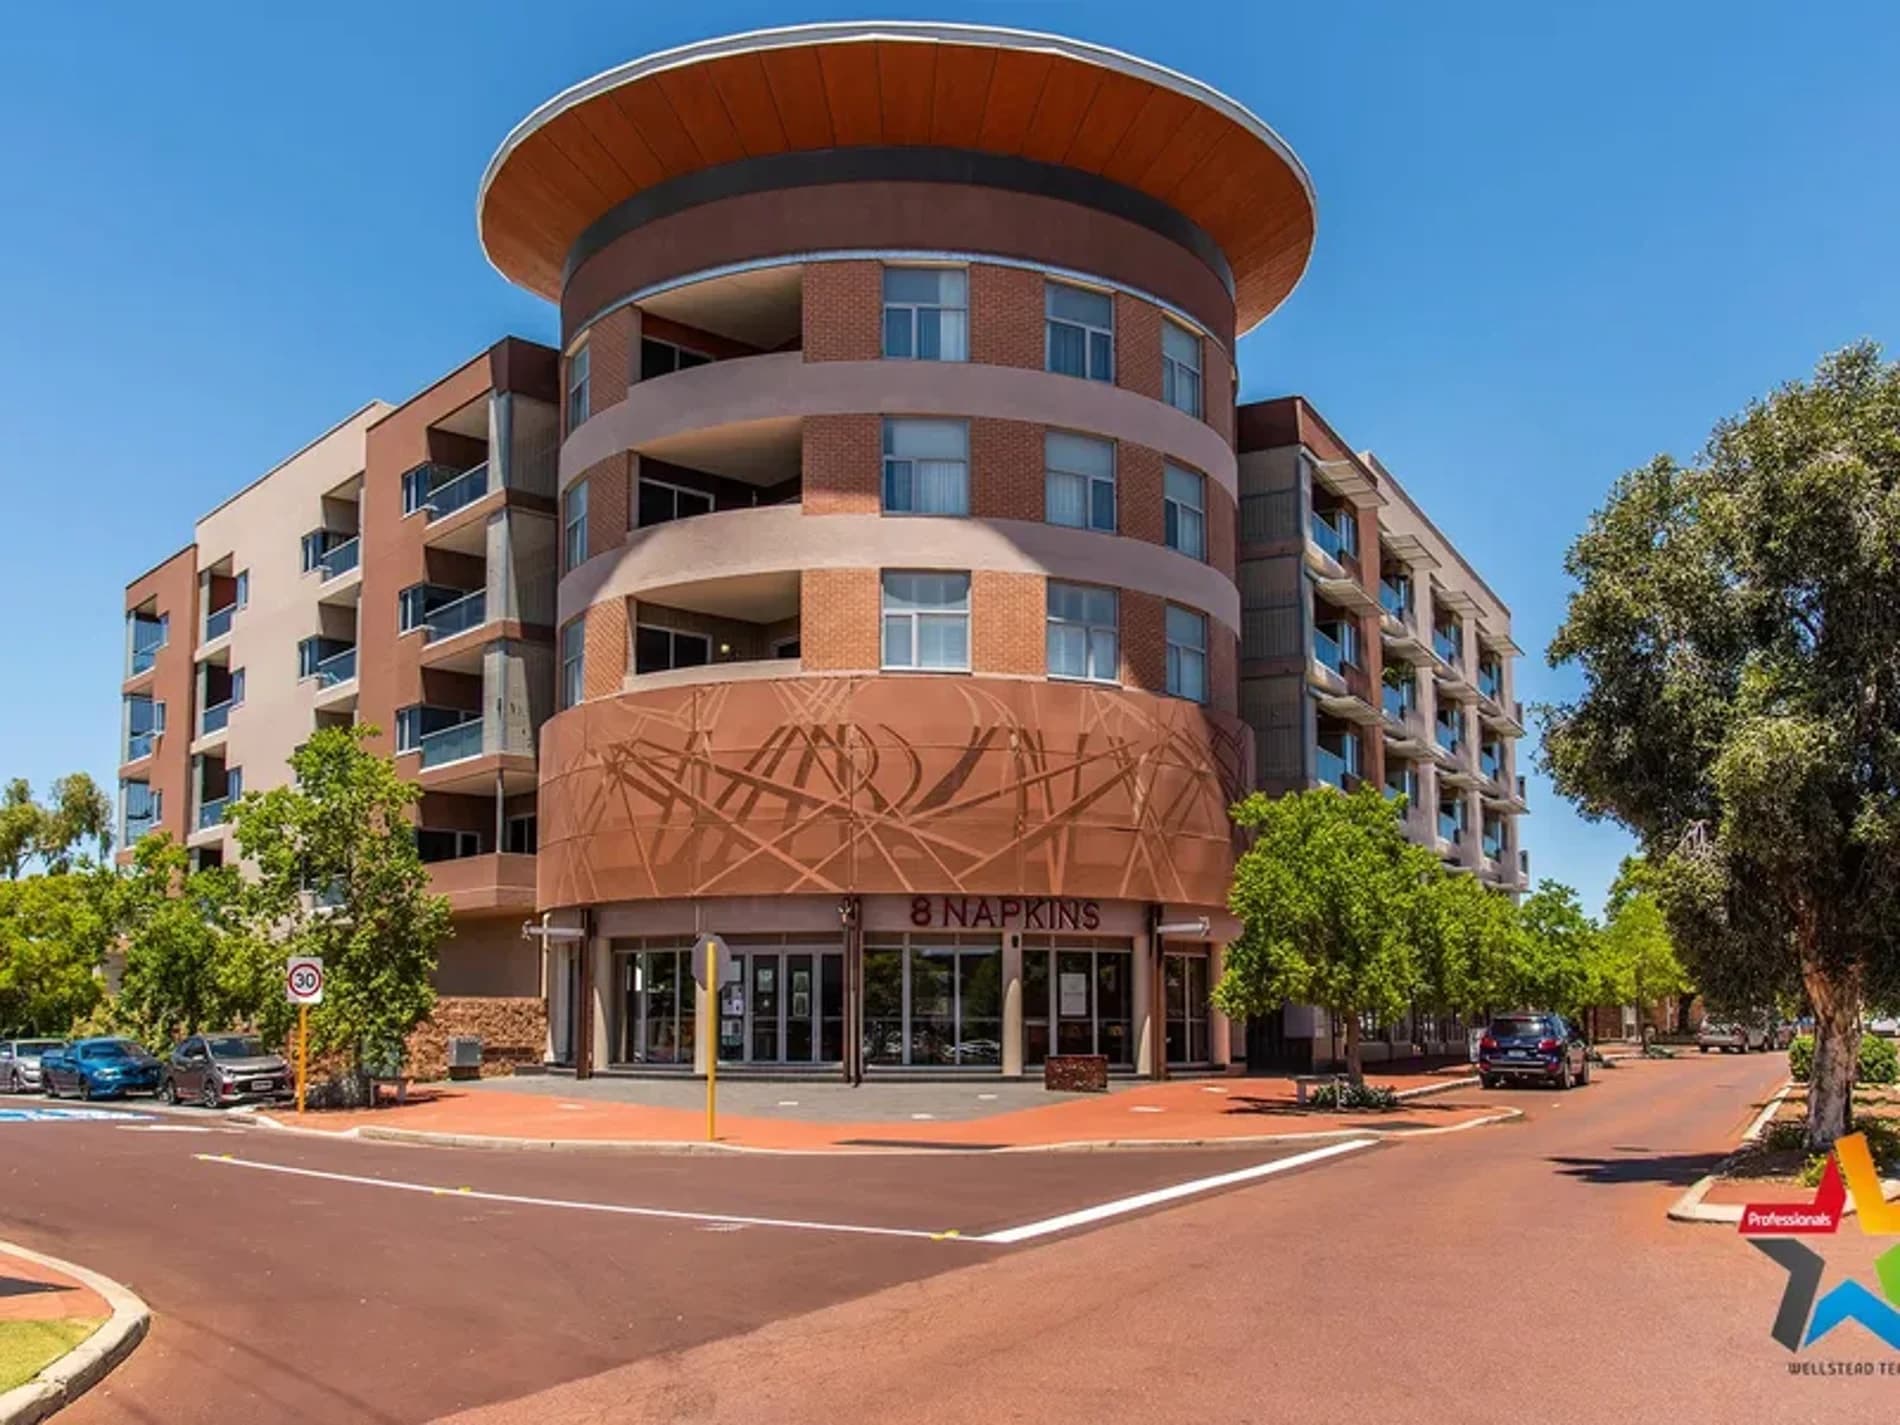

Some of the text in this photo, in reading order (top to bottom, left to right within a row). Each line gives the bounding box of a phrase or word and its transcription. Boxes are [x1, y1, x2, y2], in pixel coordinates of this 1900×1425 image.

[910, 897, 1100, 930] 8 NAPKINS
[295, 972, 316, 988] 30
